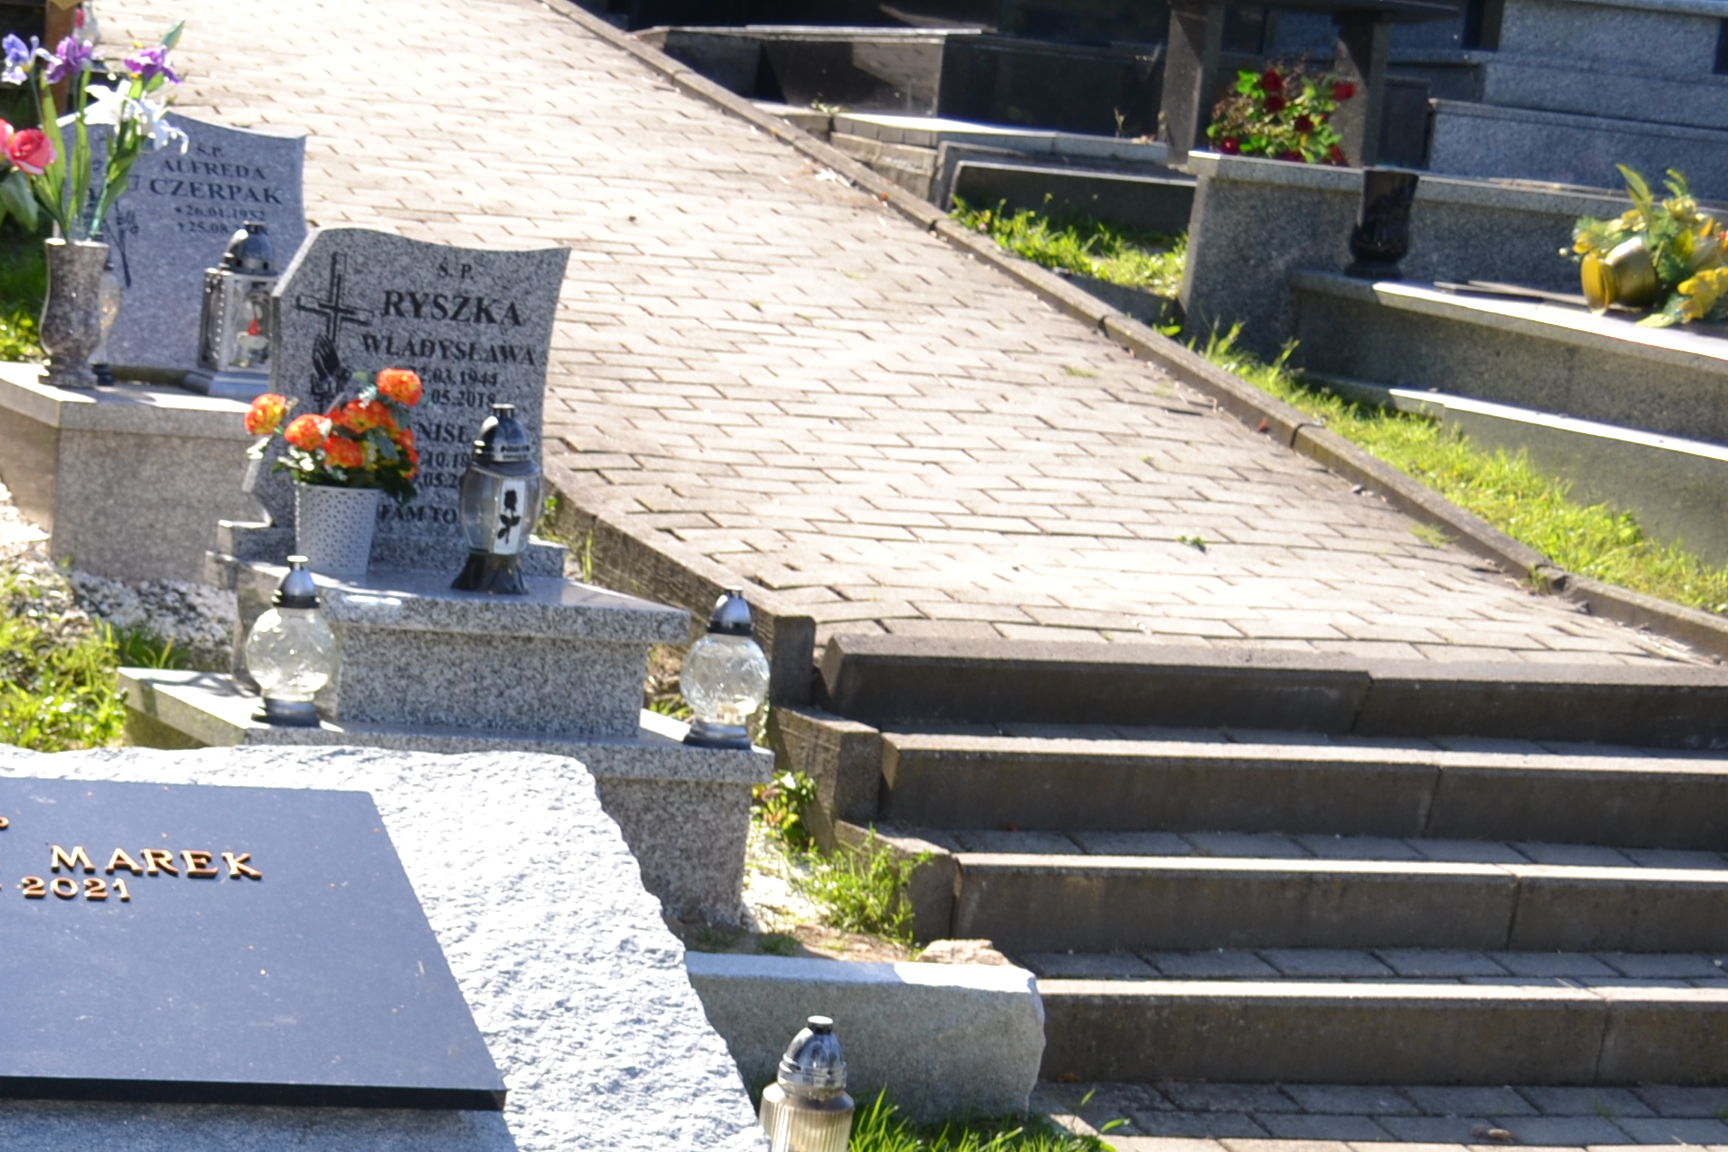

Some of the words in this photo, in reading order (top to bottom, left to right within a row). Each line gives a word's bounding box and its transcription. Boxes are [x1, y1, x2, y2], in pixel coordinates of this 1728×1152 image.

[163, 159, 267, 181] ALFREDA
[150, 179, 284, 206] CZERPAK
[382, 289, 524, 327] RYSZKA
[50, 845, 262, 880] MAREK
[24, 877, 132, 900] 2021
